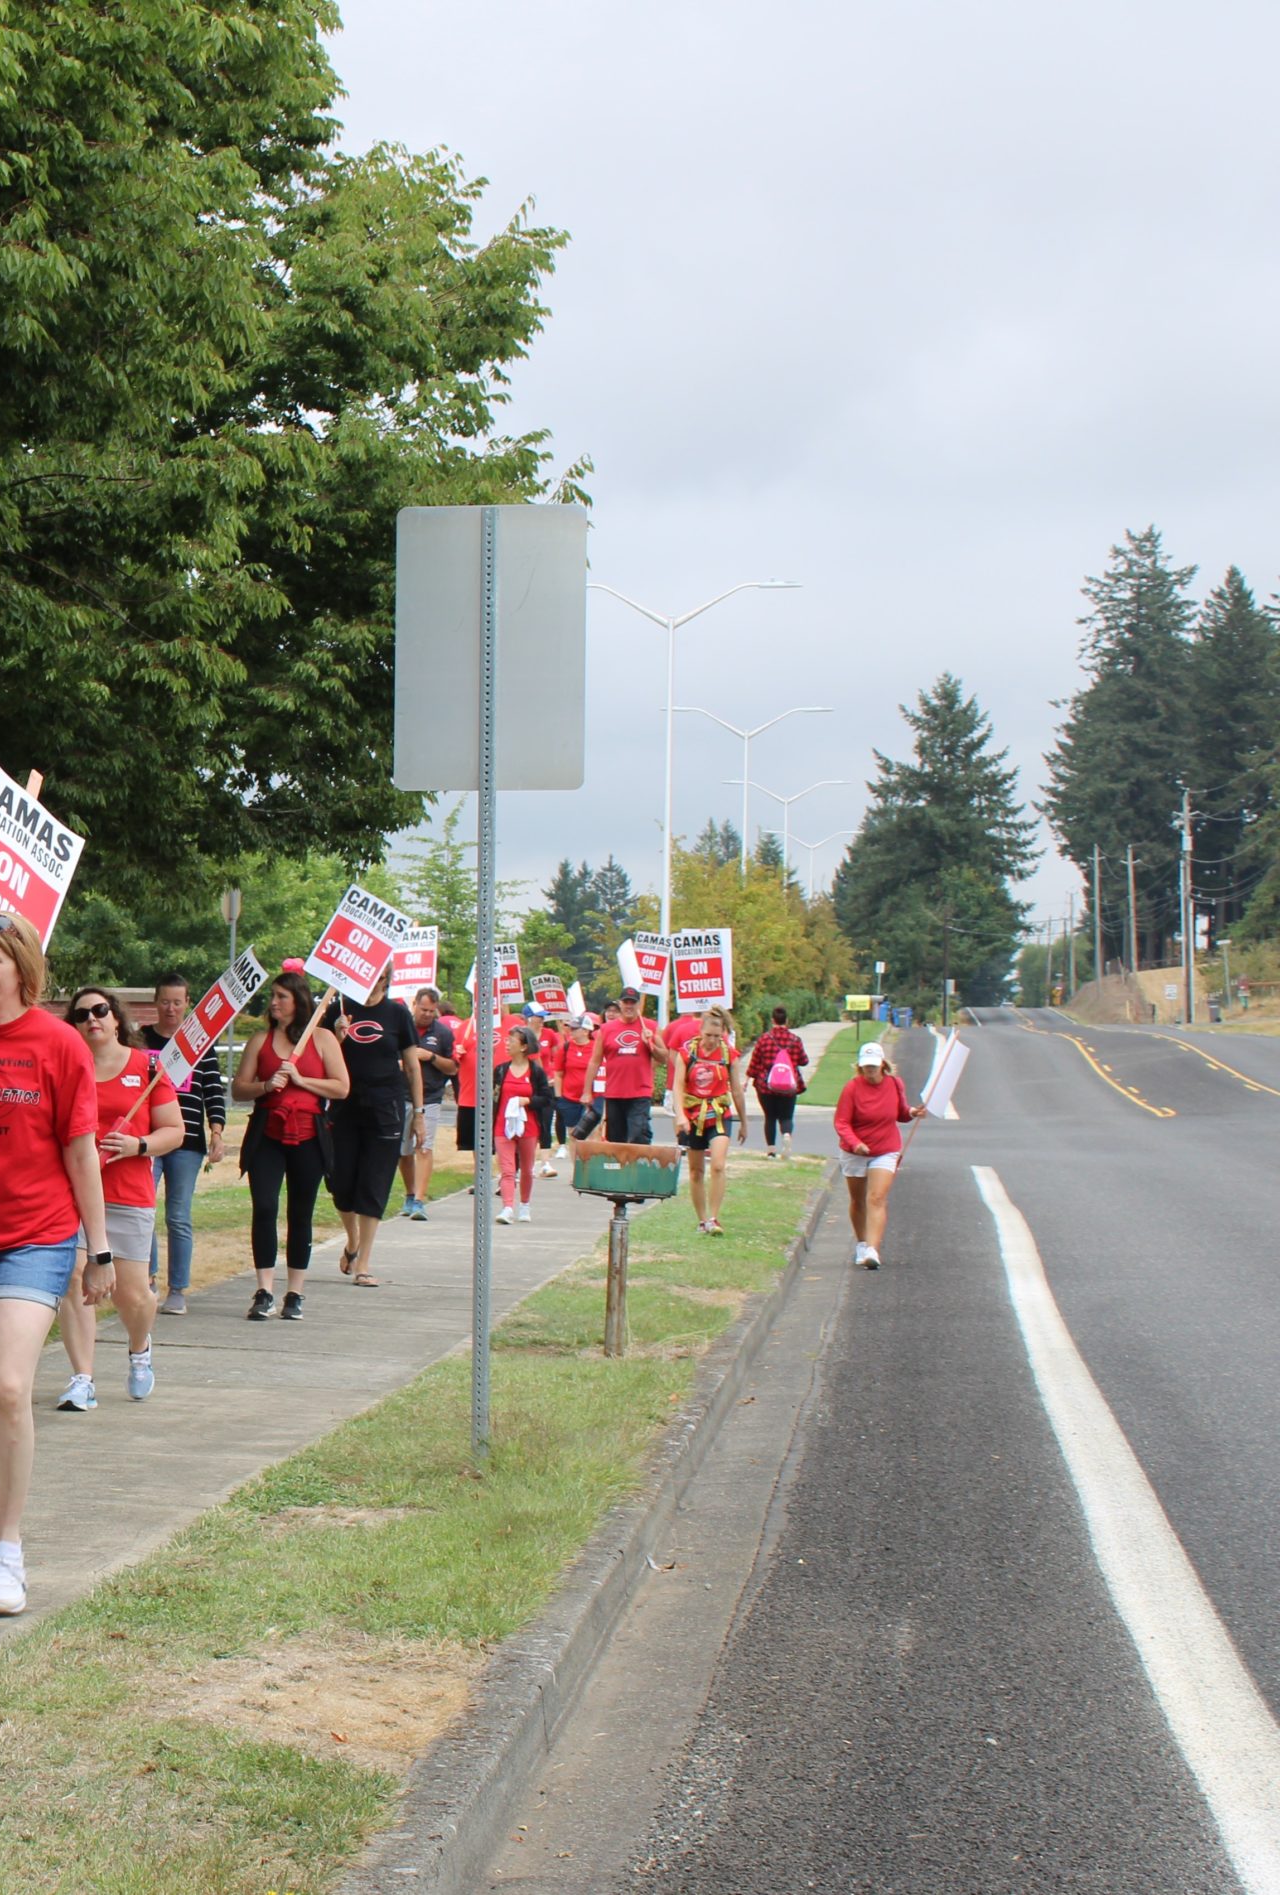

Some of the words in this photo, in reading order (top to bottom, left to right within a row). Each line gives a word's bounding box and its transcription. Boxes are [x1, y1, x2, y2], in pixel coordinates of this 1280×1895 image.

[30, 842, 64, 881] ASSOC.
[340, 902, 377, 927] EDUCATION
[346, 889, 407, 933] CAMAS
[348, 928, 374, 953] ON
[402, 930, 436, 941] AMAS
[637, 934, 672, 947] CAMAS
[673, 934, 721, 949] CAMAS
[321, 938, 376, 981] STRIKE!
[405, 952, 421, 965] ON
[642, 954, 657, 966] ON
[232, 956, 262, 993] AMAS
[392, 967, 433, 981] STRIKE!
[689, 961, 708, 975] ON
[331, 968, 348, 985] WEA
[679, 977, 722, 993] STRIKE!
[544, 991, 558, 999] ON
[204, 993, 224, 1020] ON
